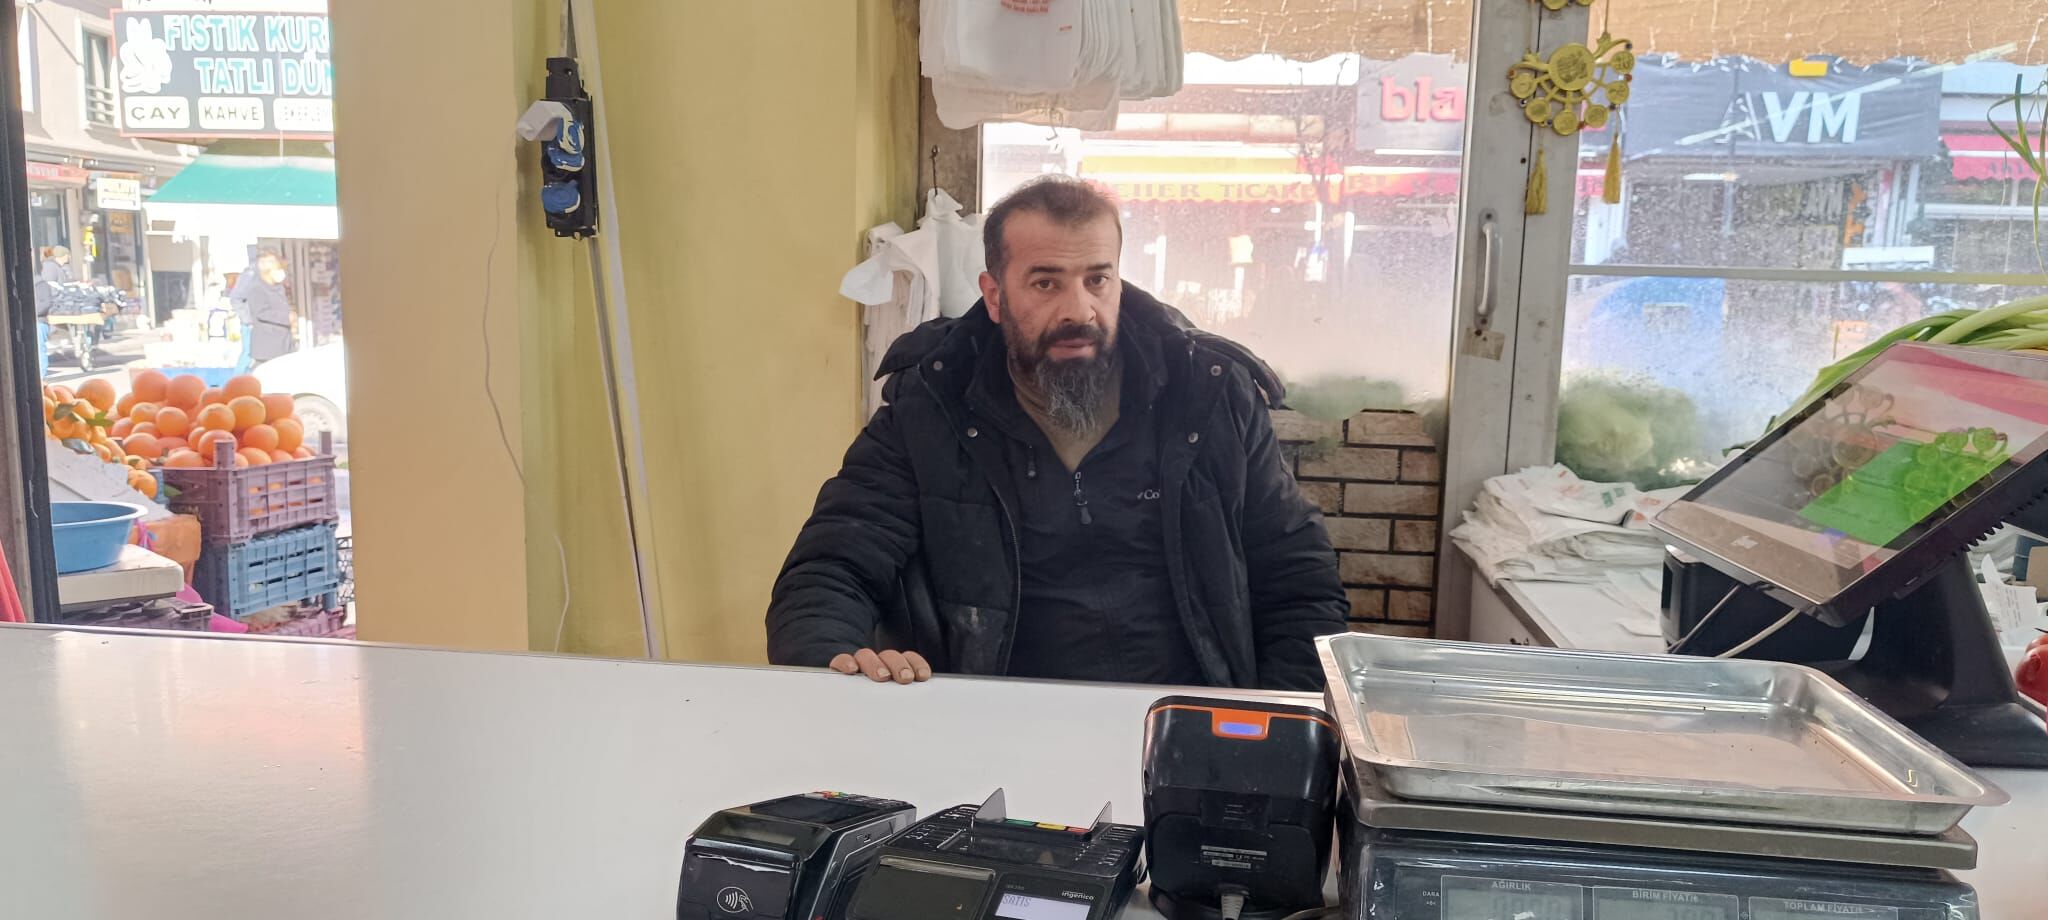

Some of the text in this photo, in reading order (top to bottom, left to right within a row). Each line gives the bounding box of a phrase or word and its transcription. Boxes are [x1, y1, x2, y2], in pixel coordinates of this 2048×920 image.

[163, 14, 331, 53] FISTIK KUR
[193, 57, 275, 94] TATLI
[131, 106, 180, 121] ÇAY
[204, 105, 260, 121] KAHVE
[1713, 91, 1862, 144] AVM
[1061, 889, 1095, 901] ingenico
